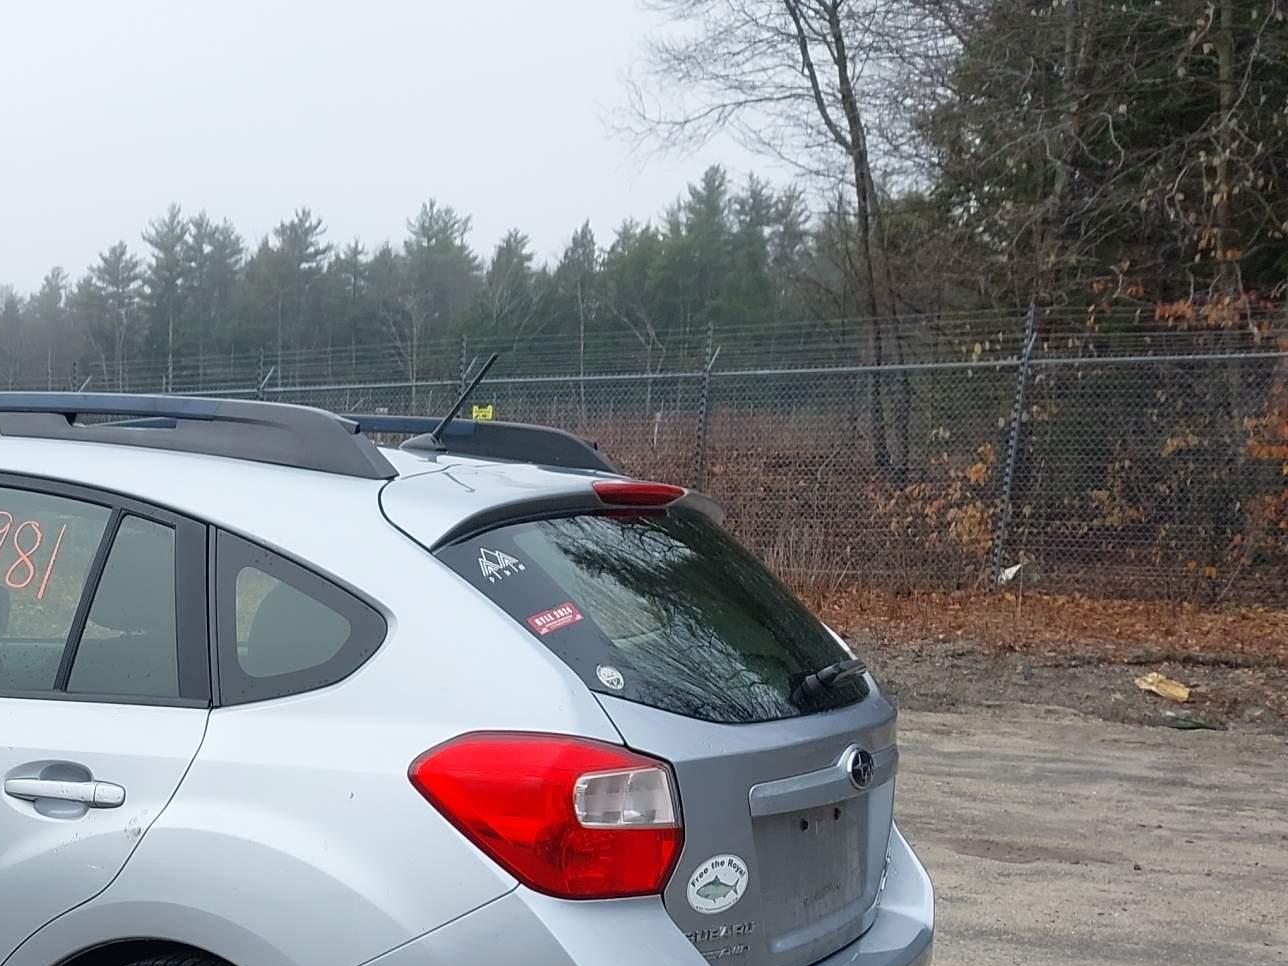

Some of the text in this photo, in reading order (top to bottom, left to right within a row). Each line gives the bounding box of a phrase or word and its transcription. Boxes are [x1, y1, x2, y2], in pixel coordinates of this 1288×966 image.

[690, 858, 746, 888] Free the Royal
